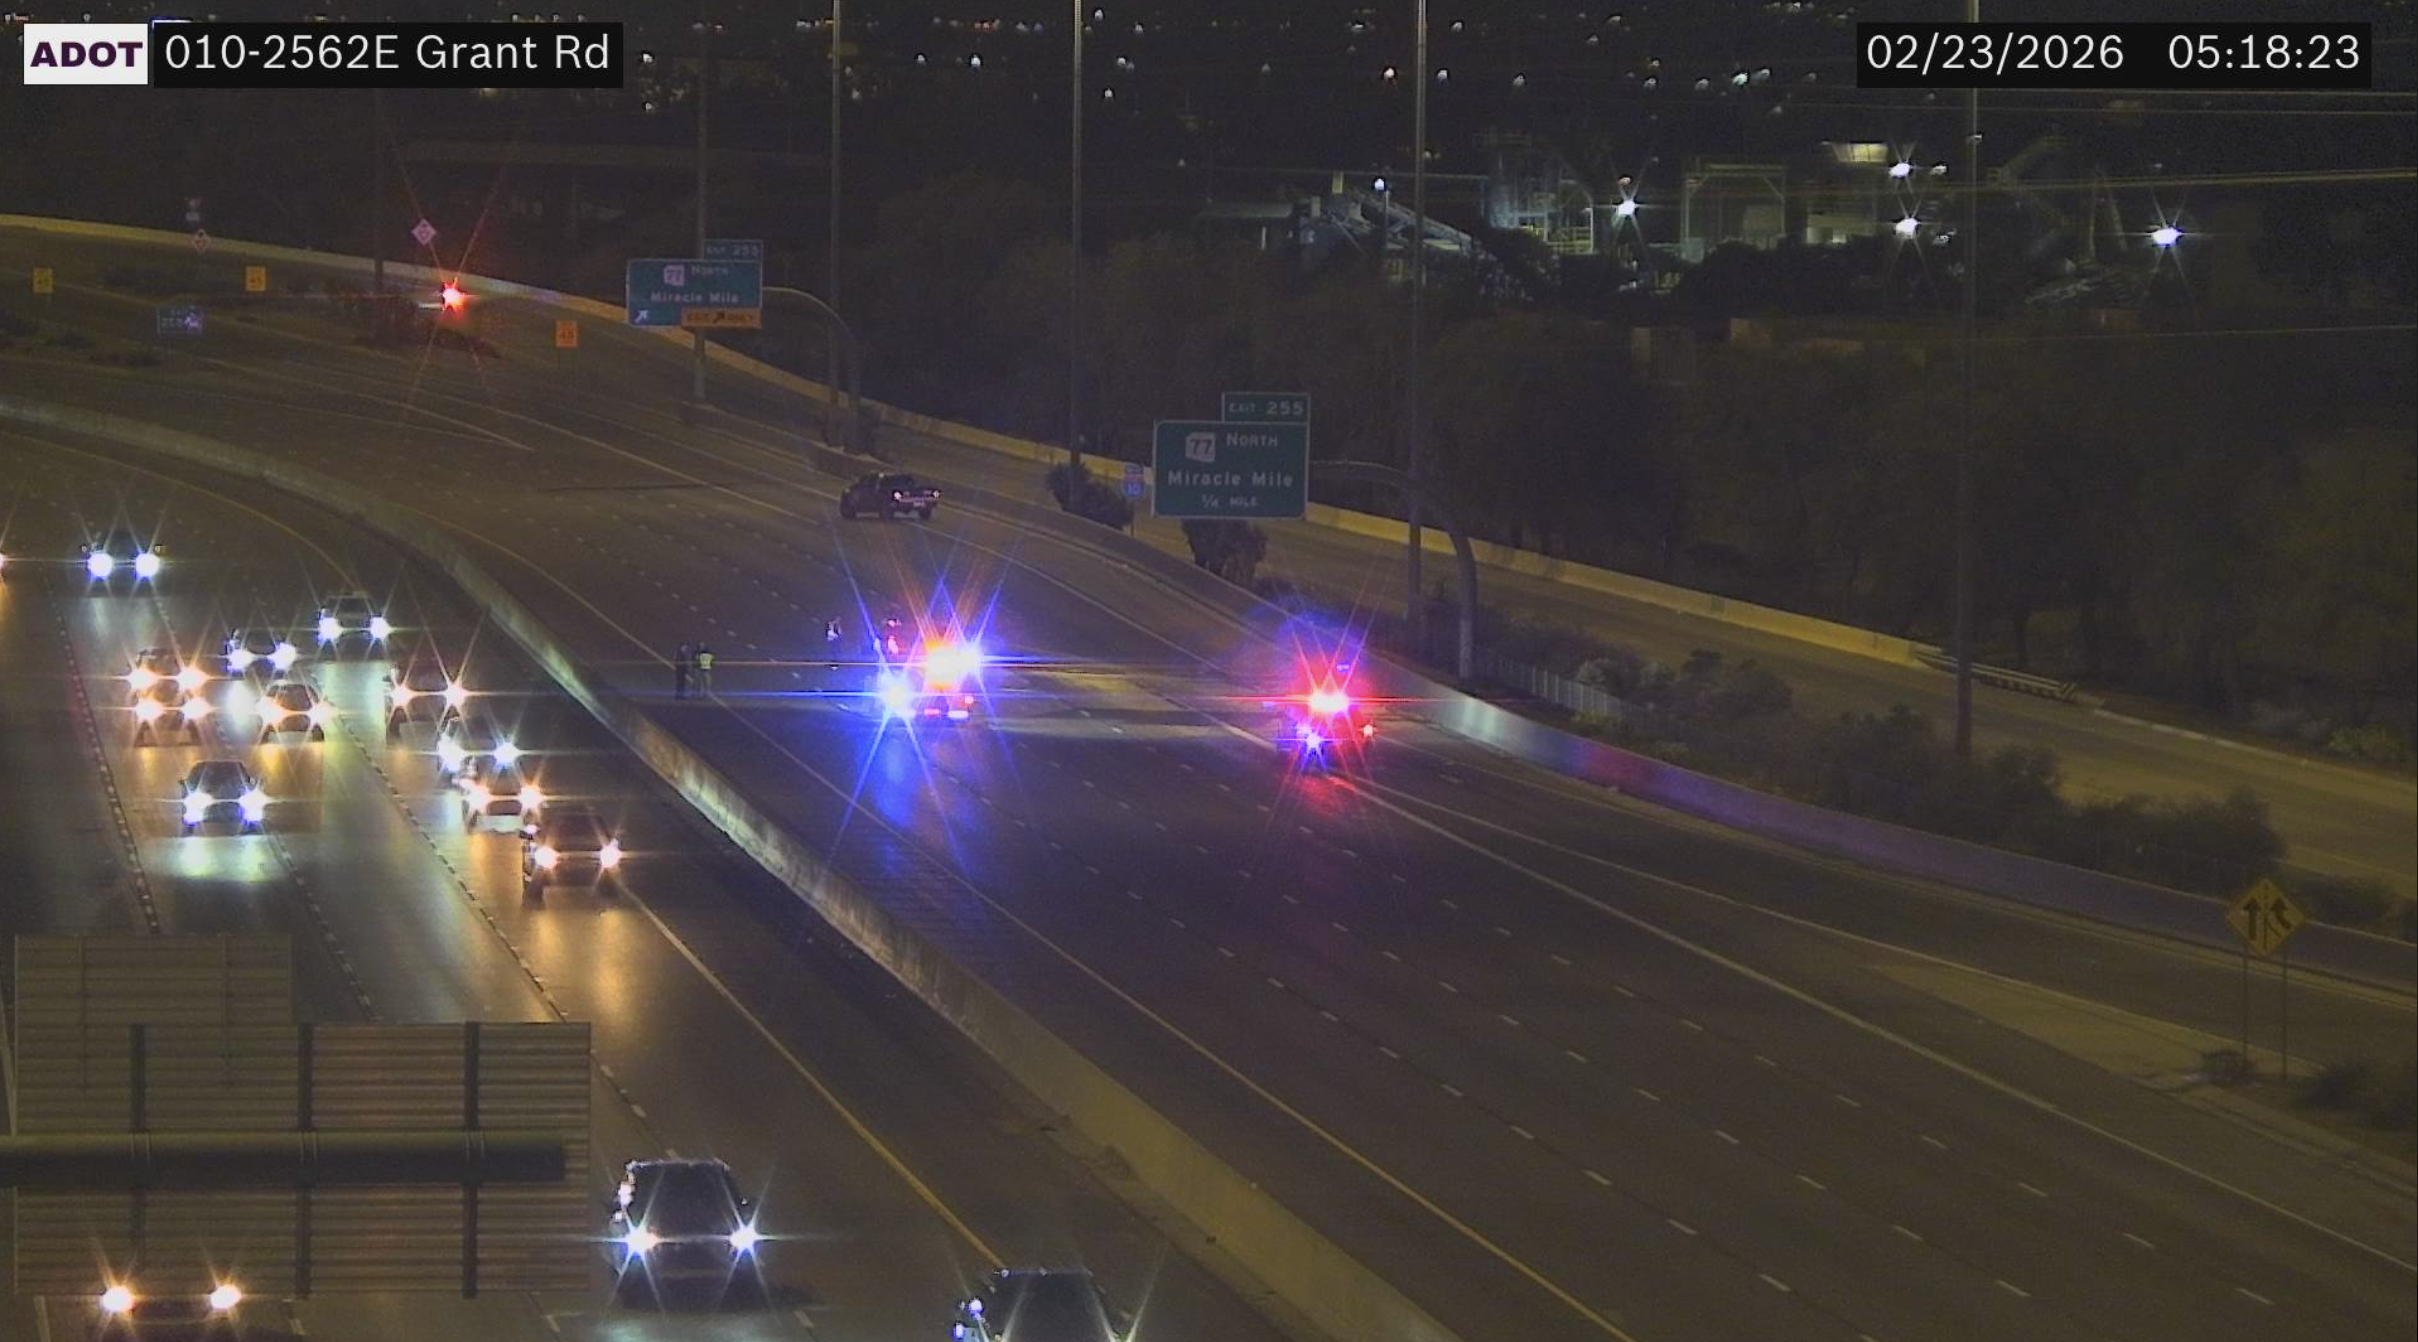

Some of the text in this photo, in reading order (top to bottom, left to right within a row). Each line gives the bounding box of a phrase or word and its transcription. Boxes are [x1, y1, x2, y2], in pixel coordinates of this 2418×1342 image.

[650, 291, 739, 304] Miracle Mile
[1229, 401, 1304, 416] EXIT 255
[1191, 438, 1213, 455] 77
[1226, 432, 1278, 447] NORTH
[1167, 470, 1293, 487] Miracle Mile
[1229, 496, 1258, 508] MILE
